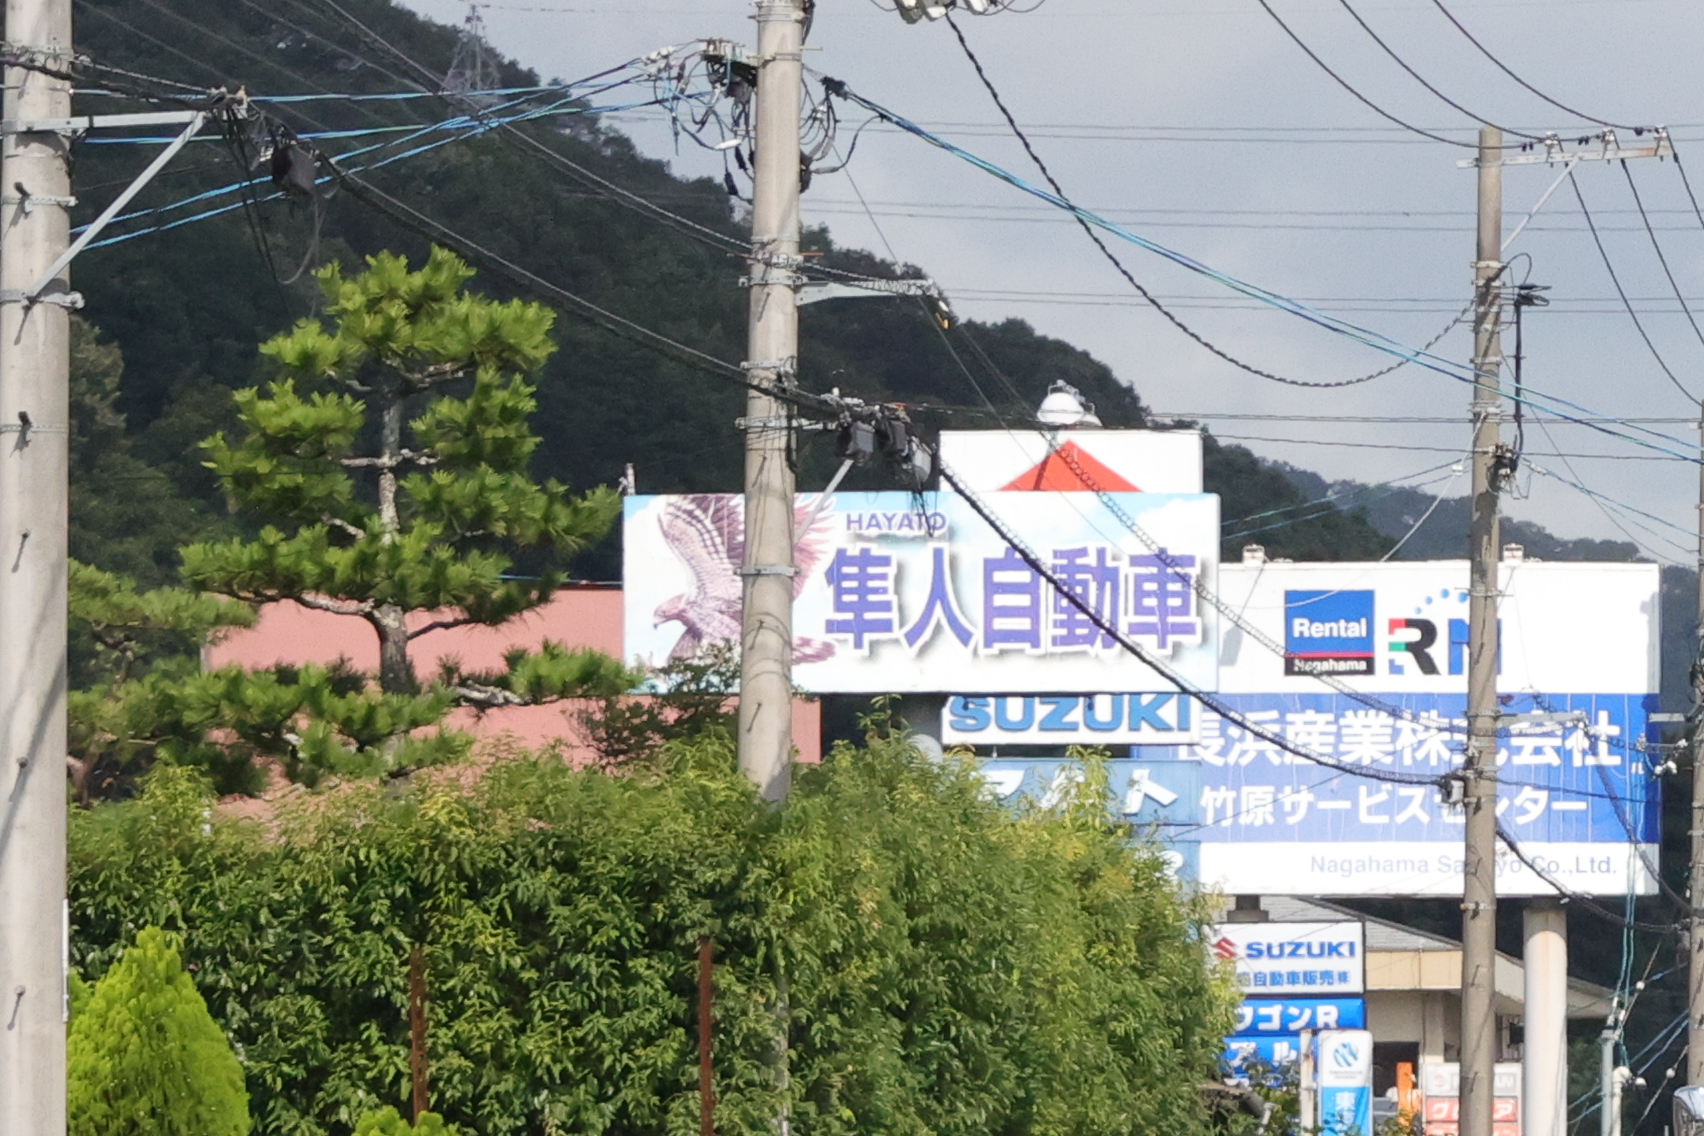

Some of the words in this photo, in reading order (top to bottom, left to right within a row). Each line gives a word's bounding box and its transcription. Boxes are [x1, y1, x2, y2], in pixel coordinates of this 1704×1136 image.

[846, 512, 948, 532] HAYATO
[825, 546, 1197, 650] 隼人自動車
[1292, 617, 1368, 638] Rental
[1294, 658, 1367, 675] Nagahama
[950, 693, 1191, 732] SUZUKI
[1178, 709, 1622, 768] 長浜産業株会社
[1200, 784, 1588, 827] 竹原サービスセター
[1311, 856, 1429, 878] Nagahama
[1437, 856, 1523, 878] Sayo
[1246, 941, 1356, 959] SUZUKI
